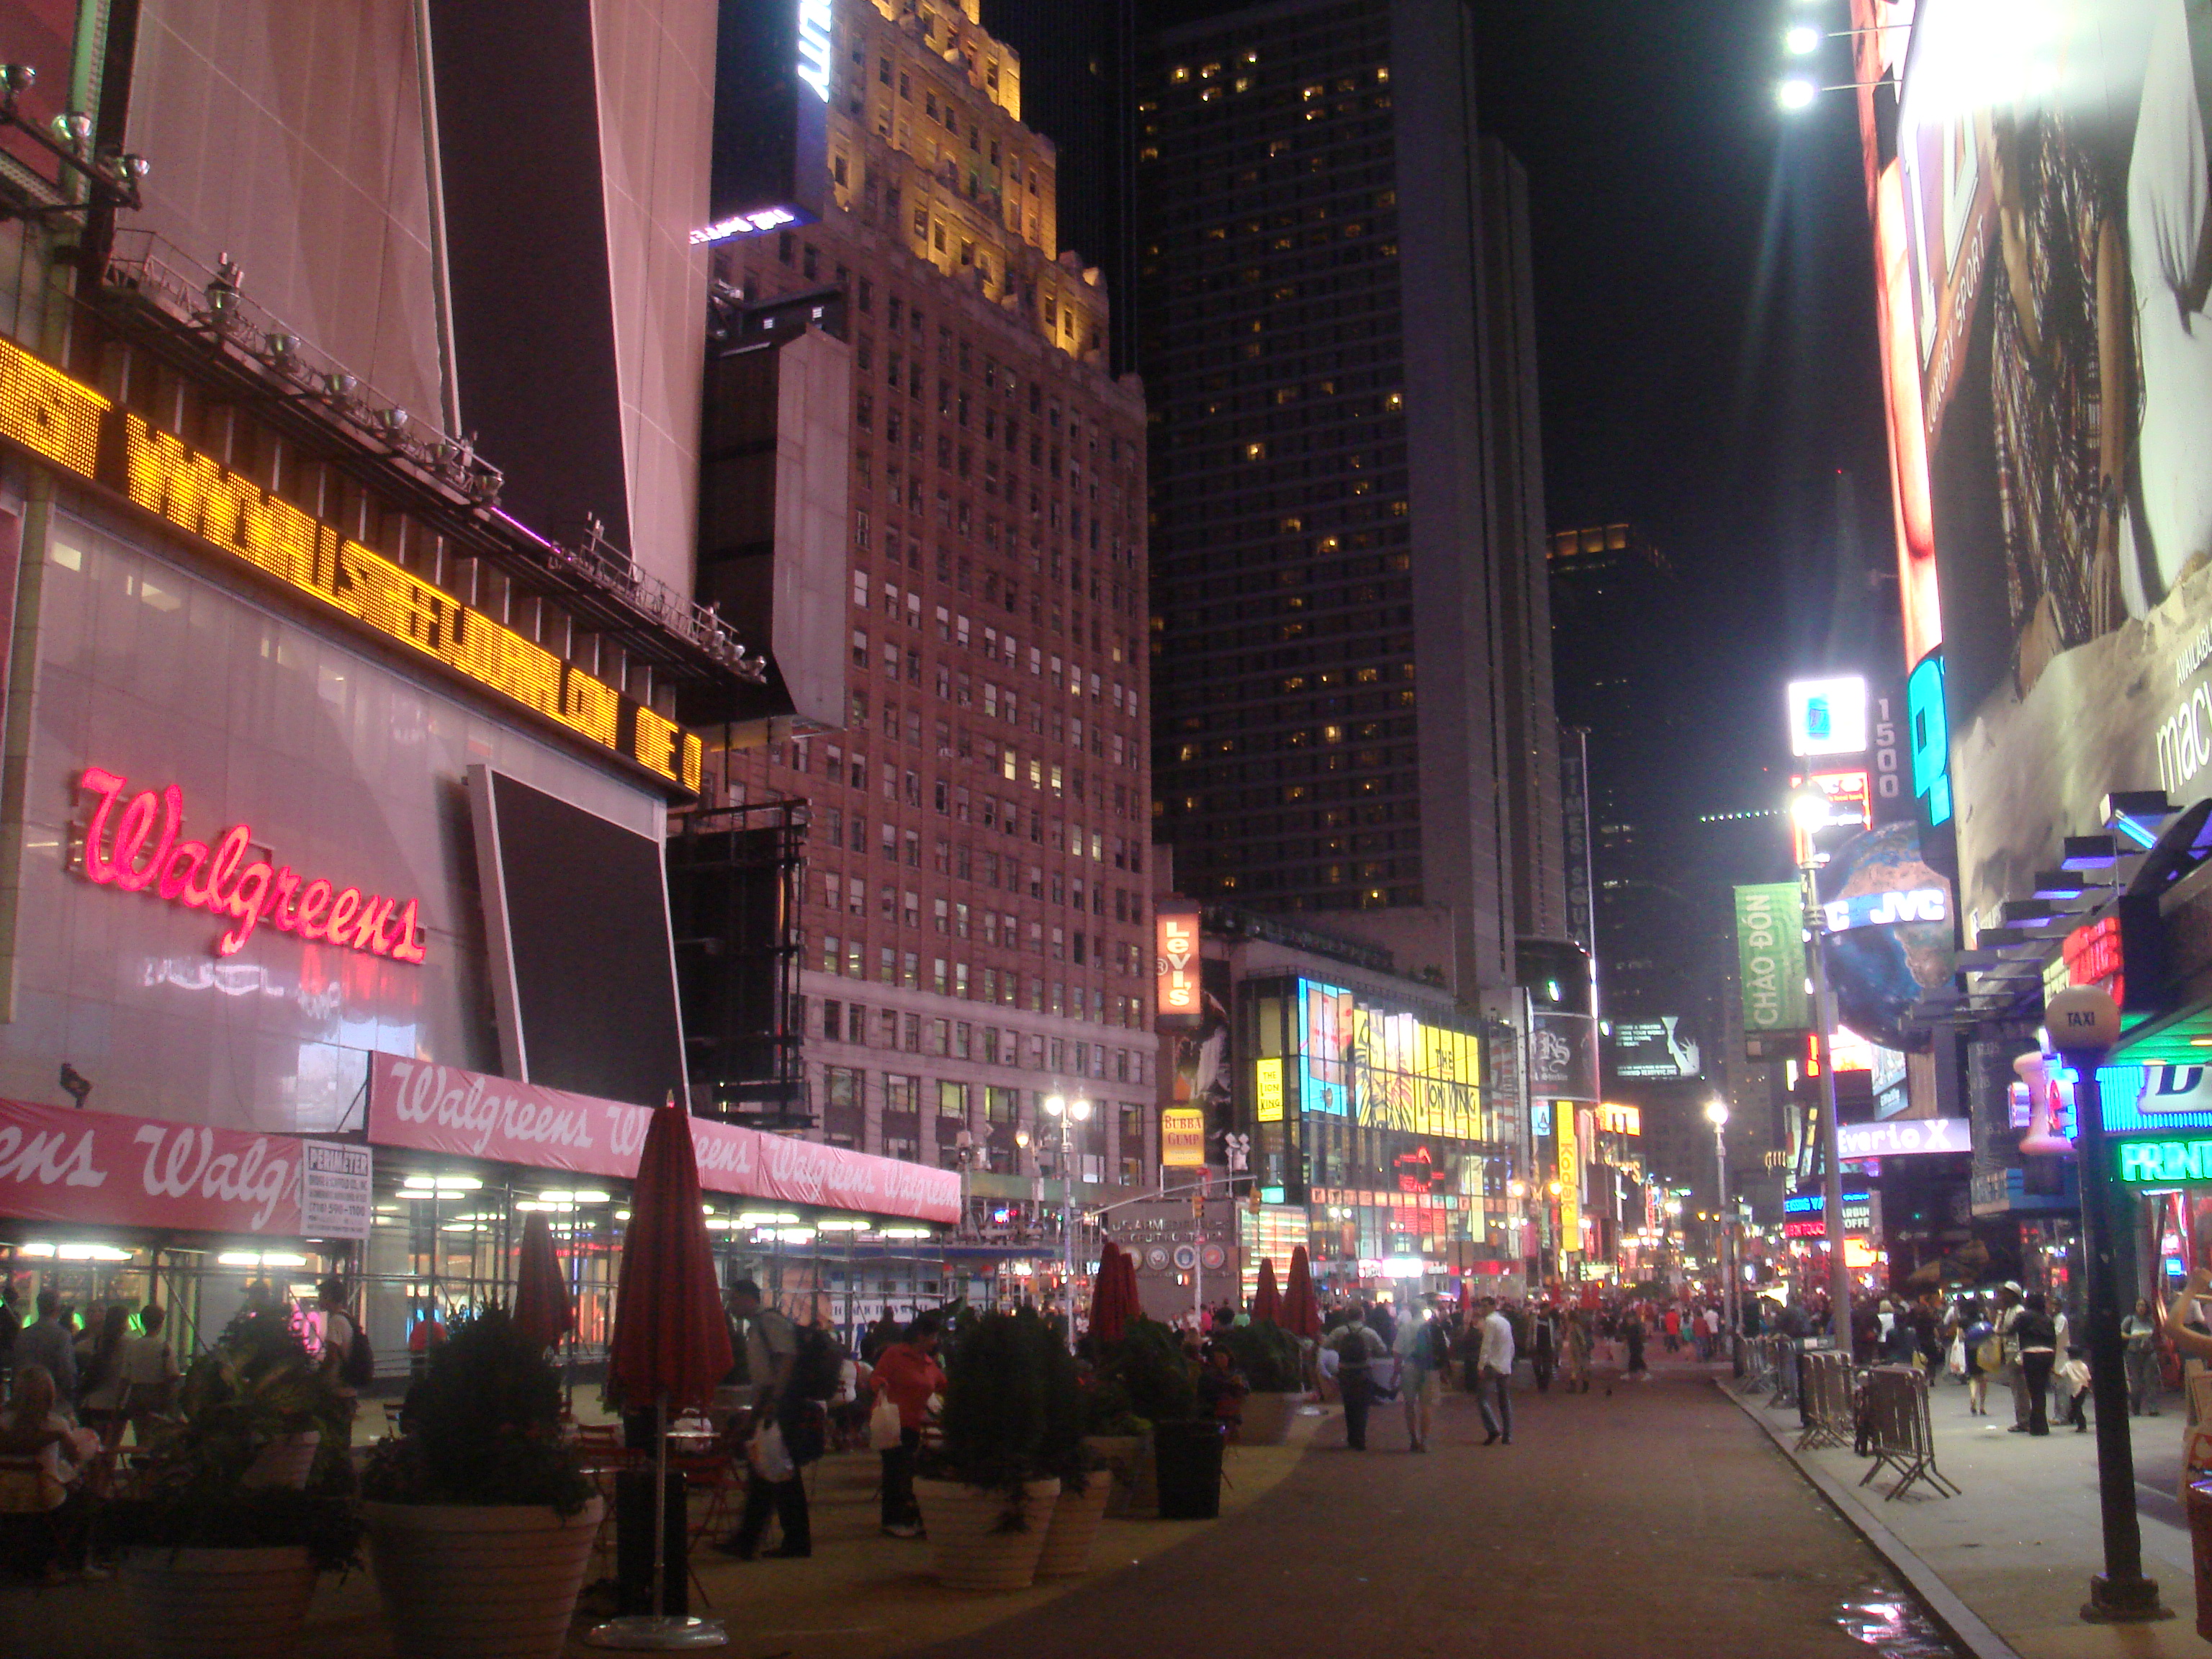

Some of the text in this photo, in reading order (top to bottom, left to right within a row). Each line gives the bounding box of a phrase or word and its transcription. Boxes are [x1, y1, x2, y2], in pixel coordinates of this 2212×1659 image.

[1955, 214, 1984, 337] SPORT
[1876, 698, 1899, 799] 1500
[81, 767, 426, 964] Walgreens
[1869, 889, 1946, 924] JVC
[2067, 1011, 2095, 1028] TAXI
[1263, 1071, 1277, 1080] THE
[1435, 1048, 1454, 1071] THE
[1260, 1083, 1280, 1097] LION
[1260, 1099, 1280, 1113] KING
[1419, 1073, 1476, 1122] LION KING
[391, 1061, 593, 1156] Walgreens
[1164, 1115, 1202, 1130] BUBBA
[1167, 1132, 1200, 1146] GUMP
[1838, 1118, 1953, 1154] Everio X
[310, 1148, 367, 1174] PERIMETER
[768, 1138, 877, 1205] Walgreens
[1559, 1142, 1573, 1213] Kodak
